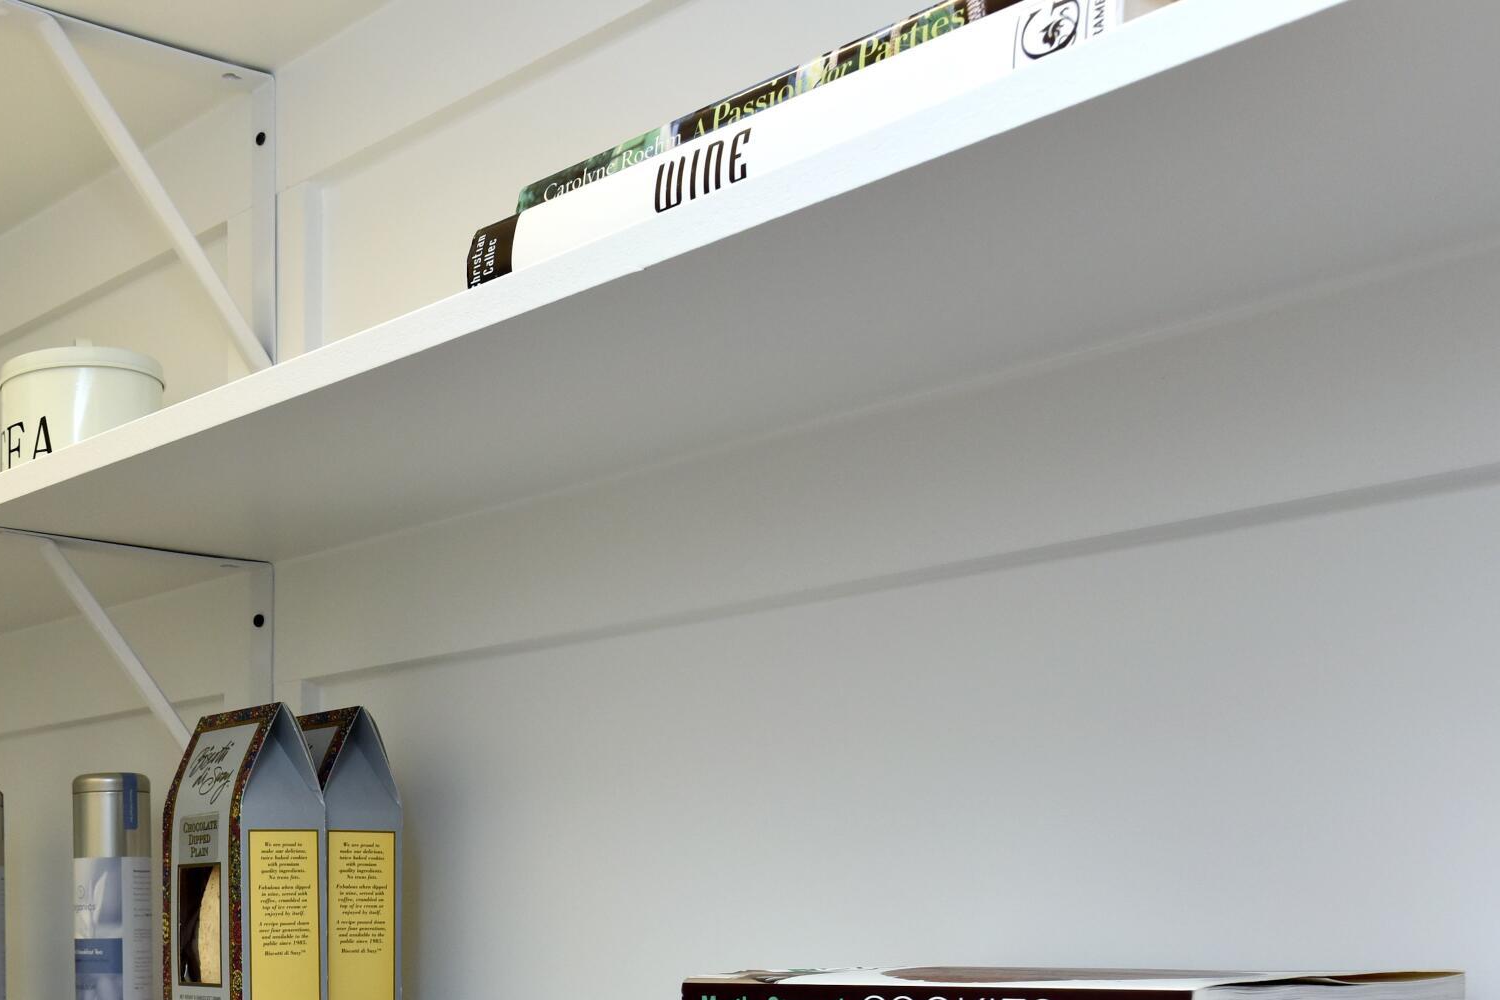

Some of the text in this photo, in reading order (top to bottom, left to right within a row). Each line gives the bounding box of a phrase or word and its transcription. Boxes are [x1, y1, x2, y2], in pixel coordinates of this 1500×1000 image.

[543, 162, 614, 201] Carolyne
[694, 118, 706, 139] A
[859, 8, 966, 70] Parties
[654, 127, 752, 213] WINE
[470, 234, 487, 287] hristian
[483, 238, 497, 276] Callec
[183, 820, 218, 833] CHOCOLATE
[188, 834, 211, 845] DIPPED
[190, 847, 209, 858] PLAIN
